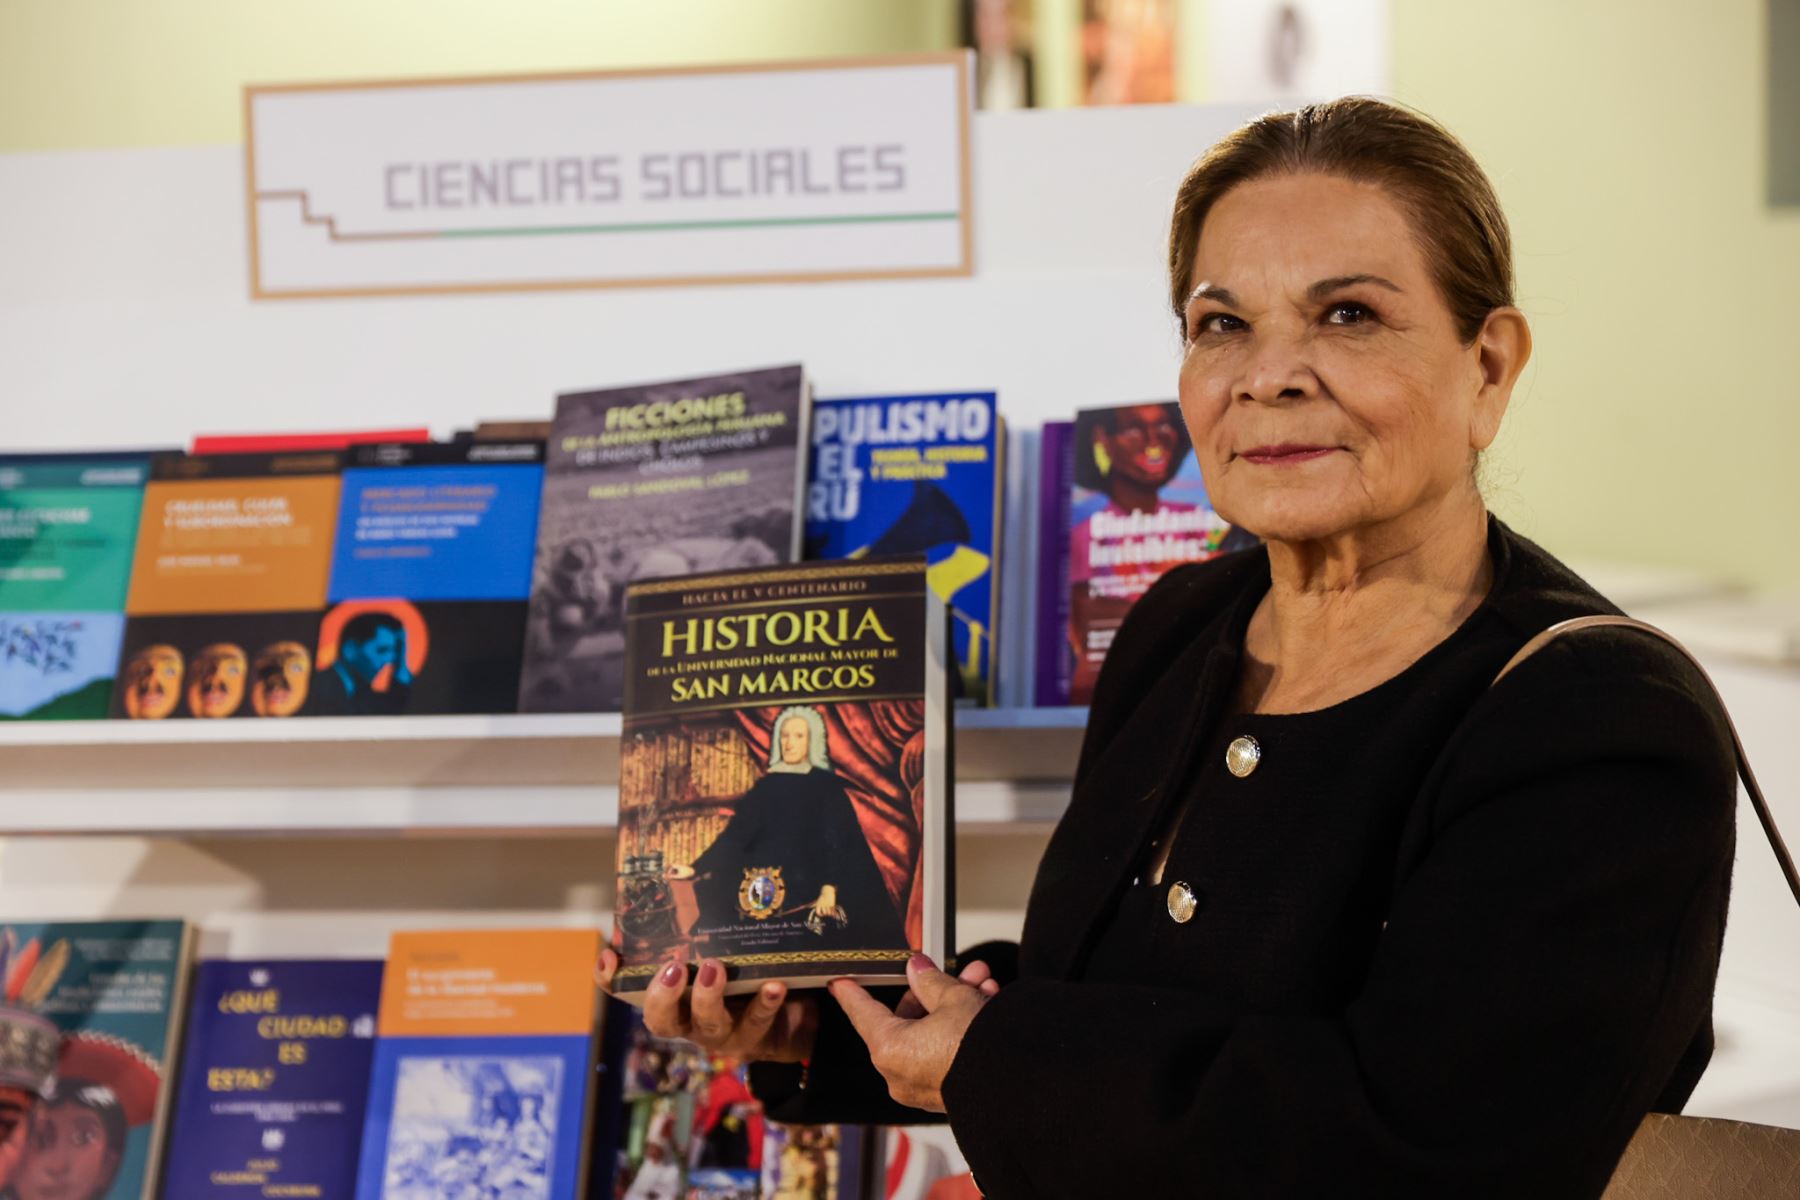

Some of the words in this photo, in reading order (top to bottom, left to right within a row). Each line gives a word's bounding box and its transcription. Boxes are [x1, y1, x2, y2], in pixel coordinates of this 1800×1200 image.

[384, 155, 622, 210] CIENCIAS
[640, 144, 905, 200] SOCIALES
[605, 392, 745, 430] FICCIONES
[818, 444, 862, 480] EL
[682, 591, 728, 606] HACIA
[732, 588, 748, 600] EL
[754, 587, 763, 598] V
[767, 580, 867, 597] CENTENARIO
[661, 607, 895, 657] HISTORIA
[647, 666, 660, 677] DE
[677, 657, 761, 673] UNIVERSIDAD
[763, 651, 826, 666] NACIONAL
[830, 649, 879, 661] MAYOR
[883, 648, 898, 659] DE
[671, 673, 731, 702] SAN
[738, 664, 876, 695] MARCOS
[257, 1015, 347, 1039] CIUDAD
[278, 1041, 307, 1065] ES
[207, 1068, 275, 1090] ESTA?
